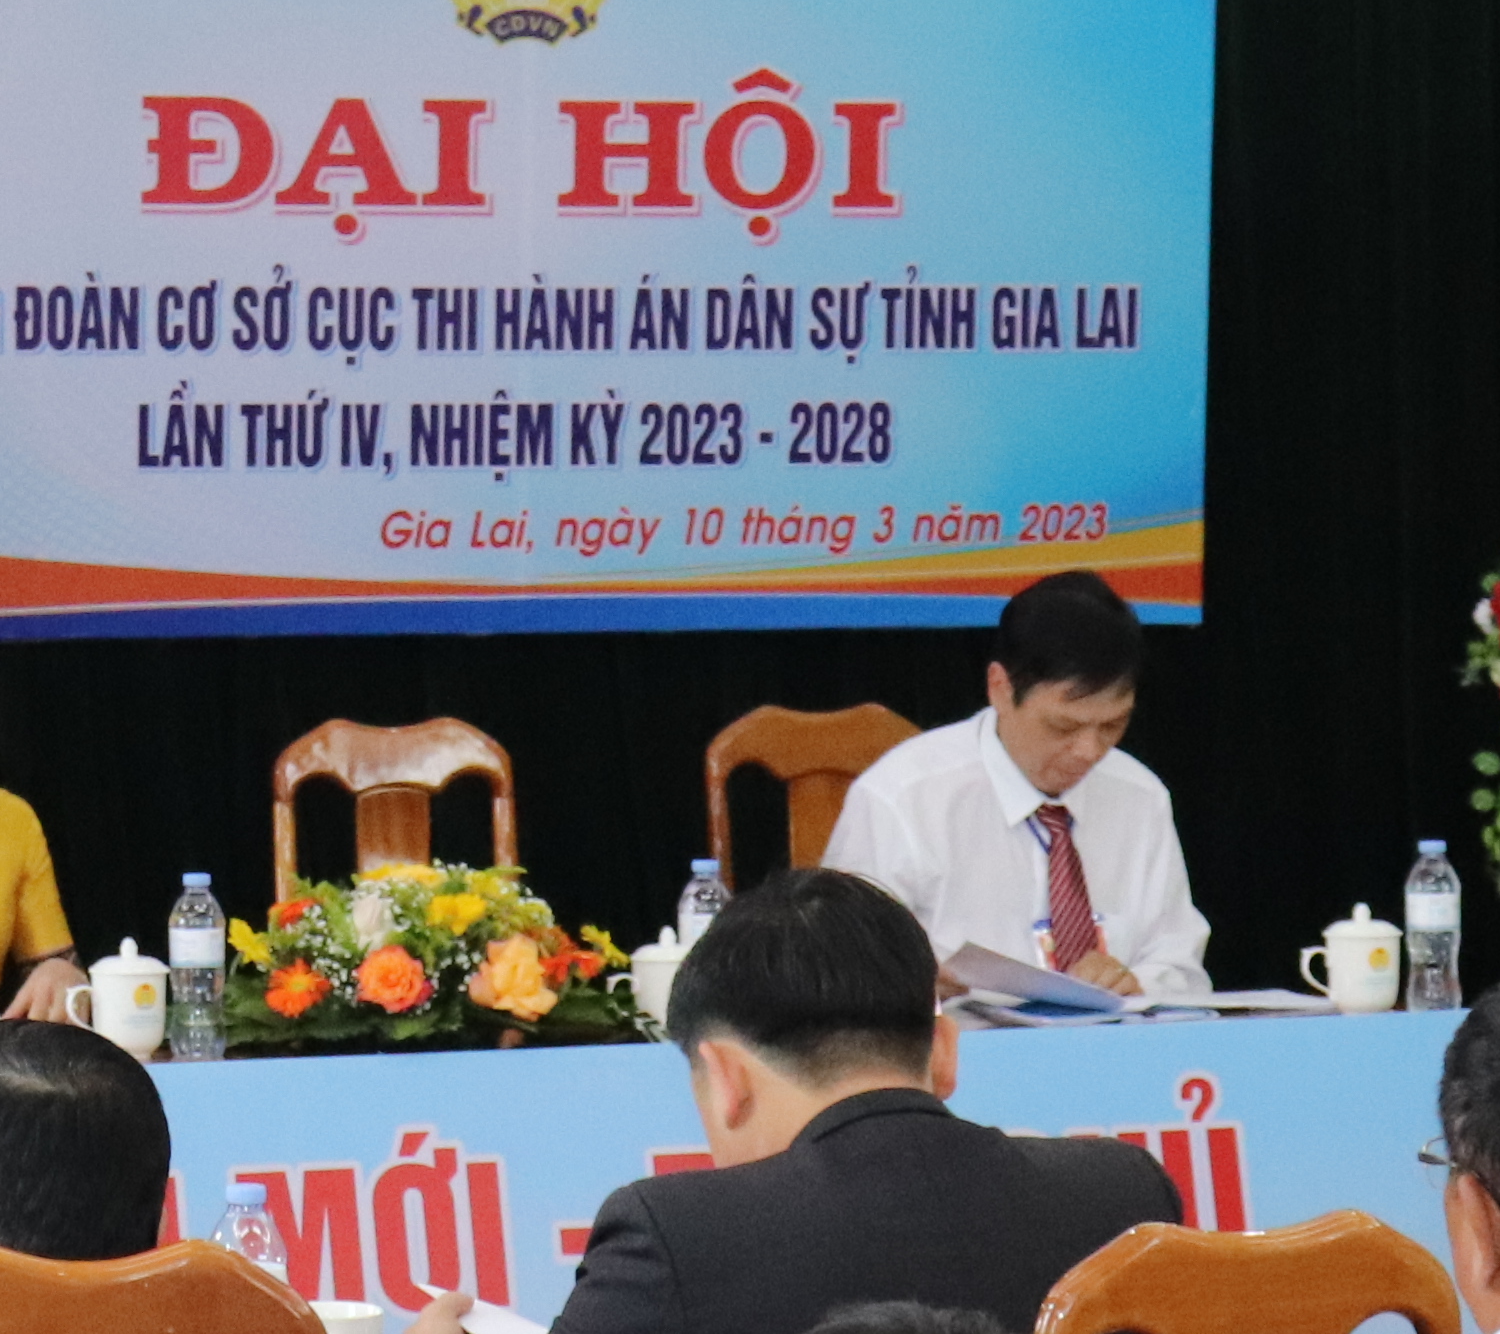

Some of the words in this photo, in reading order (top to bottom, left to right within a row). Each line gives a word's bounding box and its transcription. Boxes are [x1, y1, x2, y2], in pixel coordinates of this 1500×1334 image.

[141, 96, 490, 239] ĐẠI
[558, 67, 900, 238] HỘI
[14, 272, 140, 351] ĐOÀN
[156, 279, 218, 351] CƠ
[233, 264, 294, 350] SỞ
[307, 286, 395, 365] CỤC
[412, 287, 478, 350] THI
[494, 275, 614, 351] HÀNH
[629, 275, 690, 351] ÁN
[706, 275, 794, 351] DÂN
[809, 281, 872, 365] SỰ
[880, 266, 976, 351] TỈNH
[992, 287, 1060, 350] GIA
[1075, 286, 1139, 349] LAI
[137, 380, 224, 468] LẦN
[240, 389, 330, 468] THỨ
[340, 403, 393, 474] IV,
[410, 388, 554, 481] NHIỆM
[570, 388, 625, 467] KỲ
[638, 402, 743, 466] 2023
[758, 431, 774, 444] -
[787, 401, 892, 465] 2028
[380, 510, 453, 550] Gia
[470, 511, 534, 553] Lai,
[555, 508, 661, 557] ngày
[683, 506, 725, 545] 10
[740, 505, 857, 556] tháng
[873, 506, 895, 544] 3
[912, 503, 1001, 544] năm
[1018, 503, 1109, 543] 2023
[236, 1131, 510, 1312] MỚI
